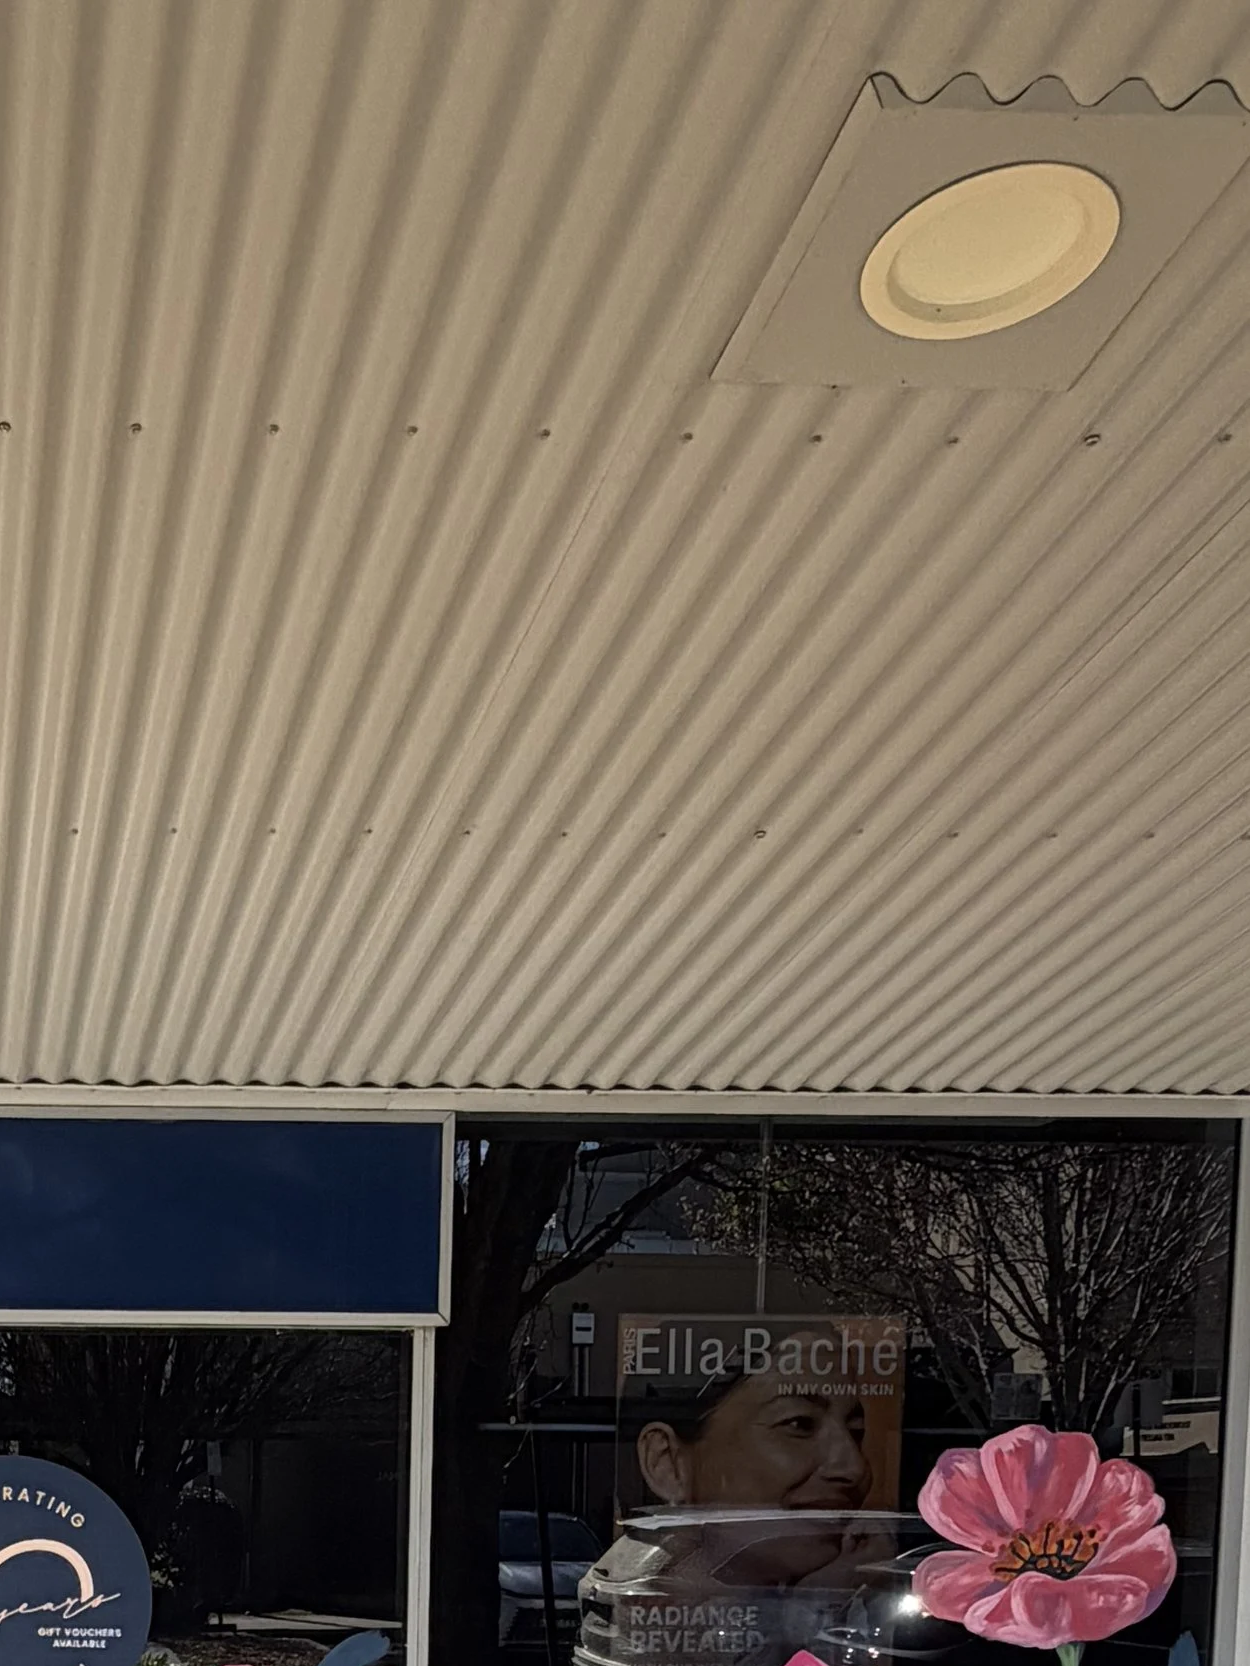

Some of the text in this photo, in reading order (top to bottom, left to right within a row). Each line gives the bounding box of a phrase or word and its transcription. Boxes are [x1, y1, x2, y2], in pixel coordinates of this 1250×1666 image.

[623, 1328, 636, 1375] PARIS
[636, 1328, 727, 1375] Ella
[778, 1383, 895, 1396] IN MY OWN SKIN
[630, 1605, 760, 1626] RADIANCE
[37, 1627, 122, 1638] GIFT VOUCHERS
[630, 1630, 766, 1653] REVEALED
[52, 1638, 107, 1649] AVAILABLE
